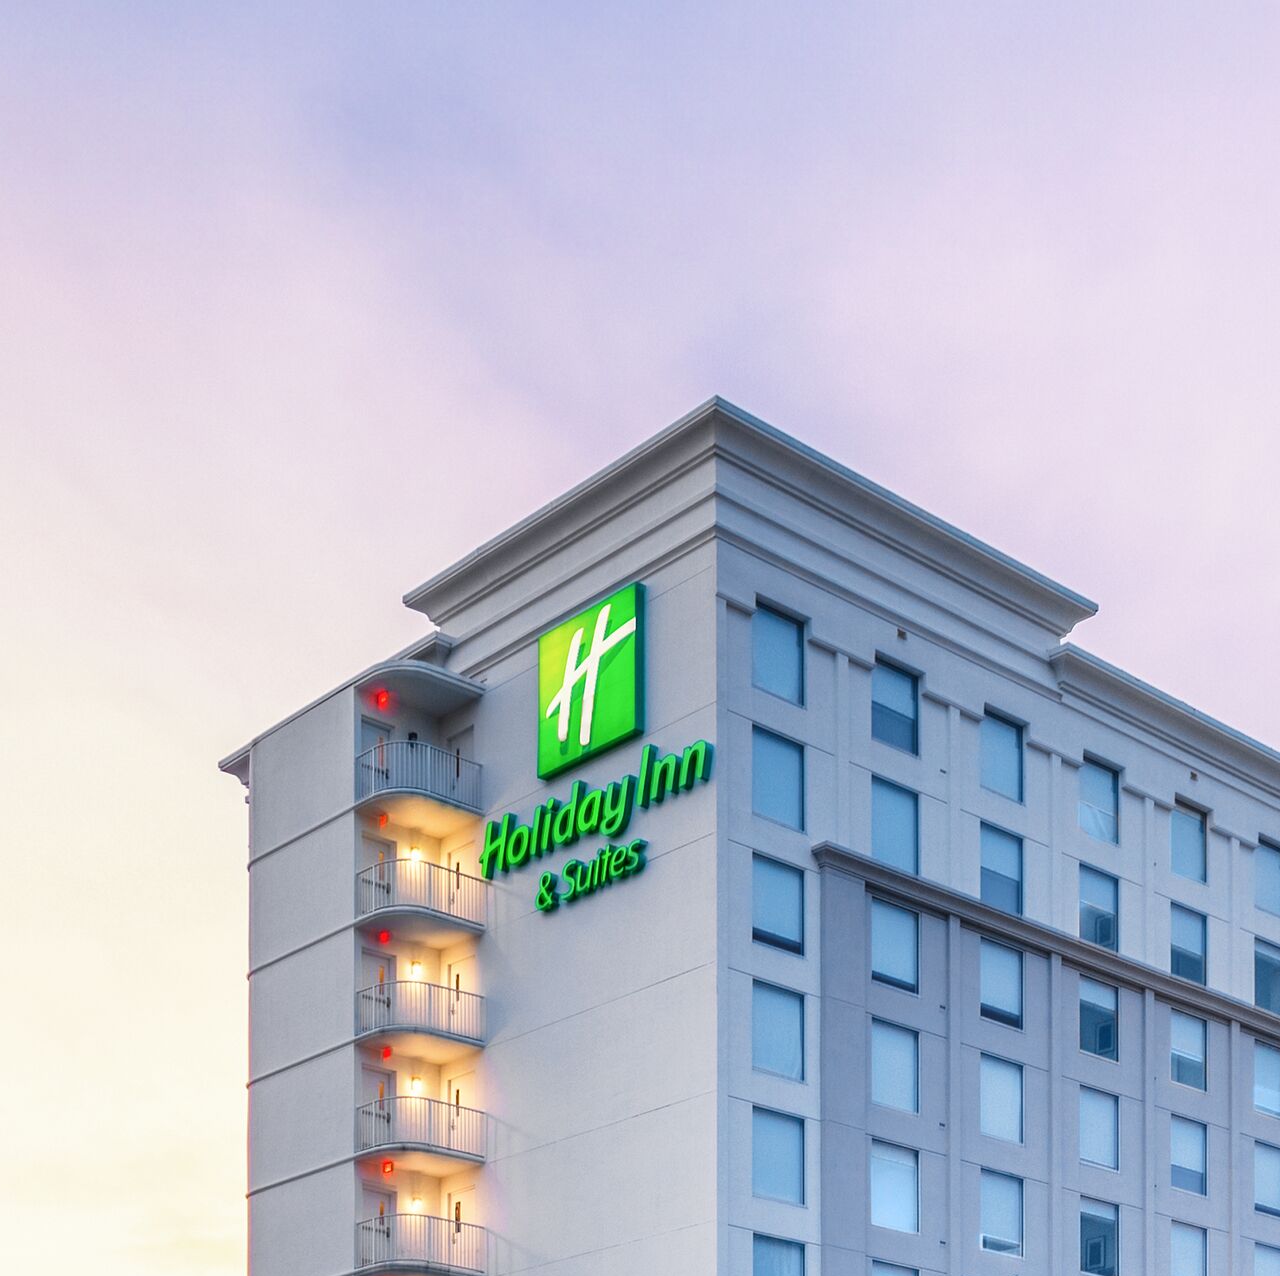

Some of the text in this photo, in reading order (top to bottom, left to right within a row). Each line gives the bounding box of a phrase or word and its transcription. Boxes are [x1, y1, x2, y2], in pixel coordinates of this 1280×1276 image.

[545, 604, 637, 746] H
[479, 739, 713, 879] Holiday Inn
[535, 839, 647, 912] & Suites
